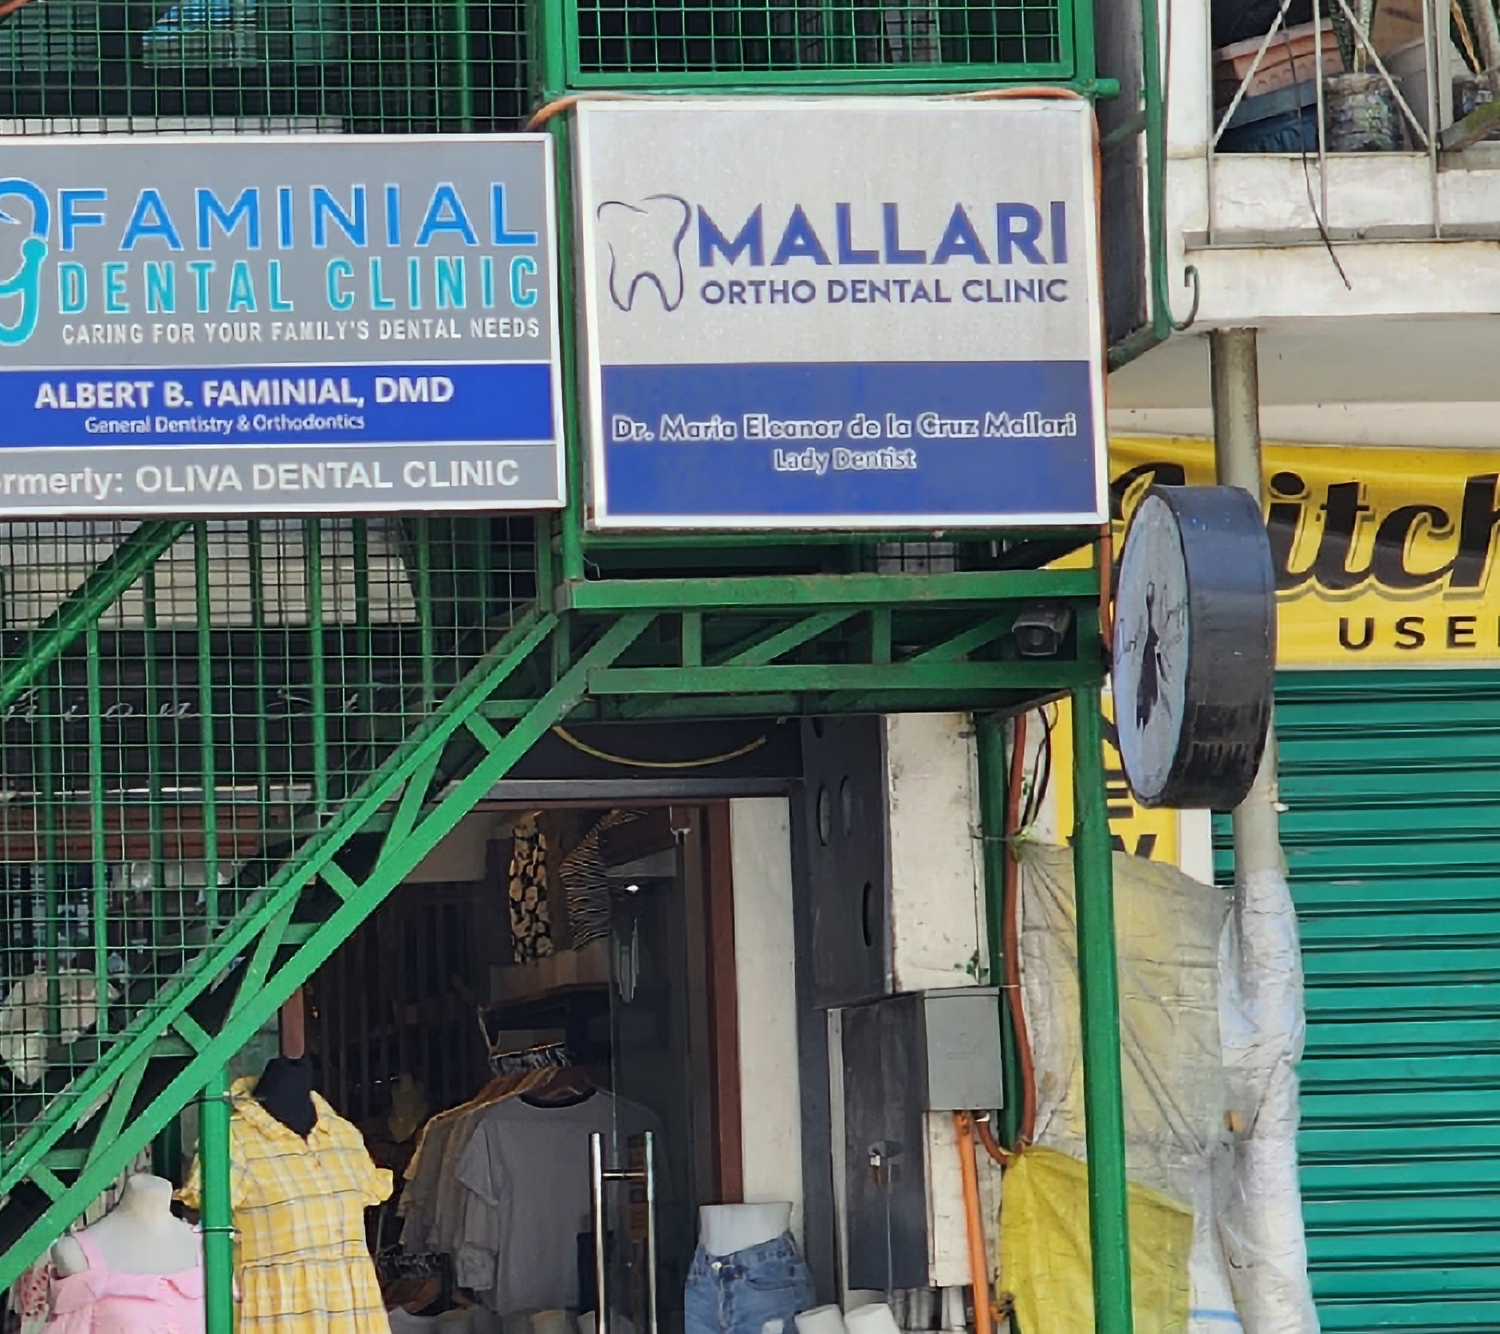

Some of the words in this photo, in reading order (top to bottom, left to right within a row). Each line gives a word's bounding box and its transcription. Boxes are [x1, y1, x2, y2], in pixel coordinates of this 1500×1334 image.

[57, 182, 538, 252] FAMINIAL
[697, 200, 1069, 267] MALLARI
[58, 256, 294, 315] DENTAL
[326, 255, 539, 312] CLINIC
[700, 279, 817, 305] ORTHO
[827, 278, 953, 304] DENTAL
[961, 277, 1069, 303] CLINIC
[61, 322, 144, 345] CARING
[151, 322, 197, 344] FOR
[204, 320, 264, 343] YOUR
[270, 319, 370, 343] FAMILY'S
[378, 317, 463, 341] DENTAL
[469, 316, 540, 339] NEEDS
[34, 381, 155, 410] ALBERT
[163, 381, 193, 409] B.
[202, 378, 366, 411] FAMINIAL,
[373, 375, 454, 405] DMD
[84, 415, 151, 435] General
[155, 414, 233, 436] Dentistry
[236, 415, 250, 432] &
[252, 413, 365, 432] Orthodontics
[611, 415, 654, 441] Dr.
[660, 414, 736, 440] Maria
[849, 413, 879, 439] de
[885, 413, 913, 439] la
[916, 413, 979, 438] Cruz
[983, 411, 1077, 438] Mallari
[135, 464, 243, 494] OLIVA
[252, 461, 393, 491] DENTAL
[402, 458, 519, 488] CLINIC
[772, 447, 829, 475] Lady
[832, 446, 917, 471] Dentist
[1338, 615, 1500, 651] USE
